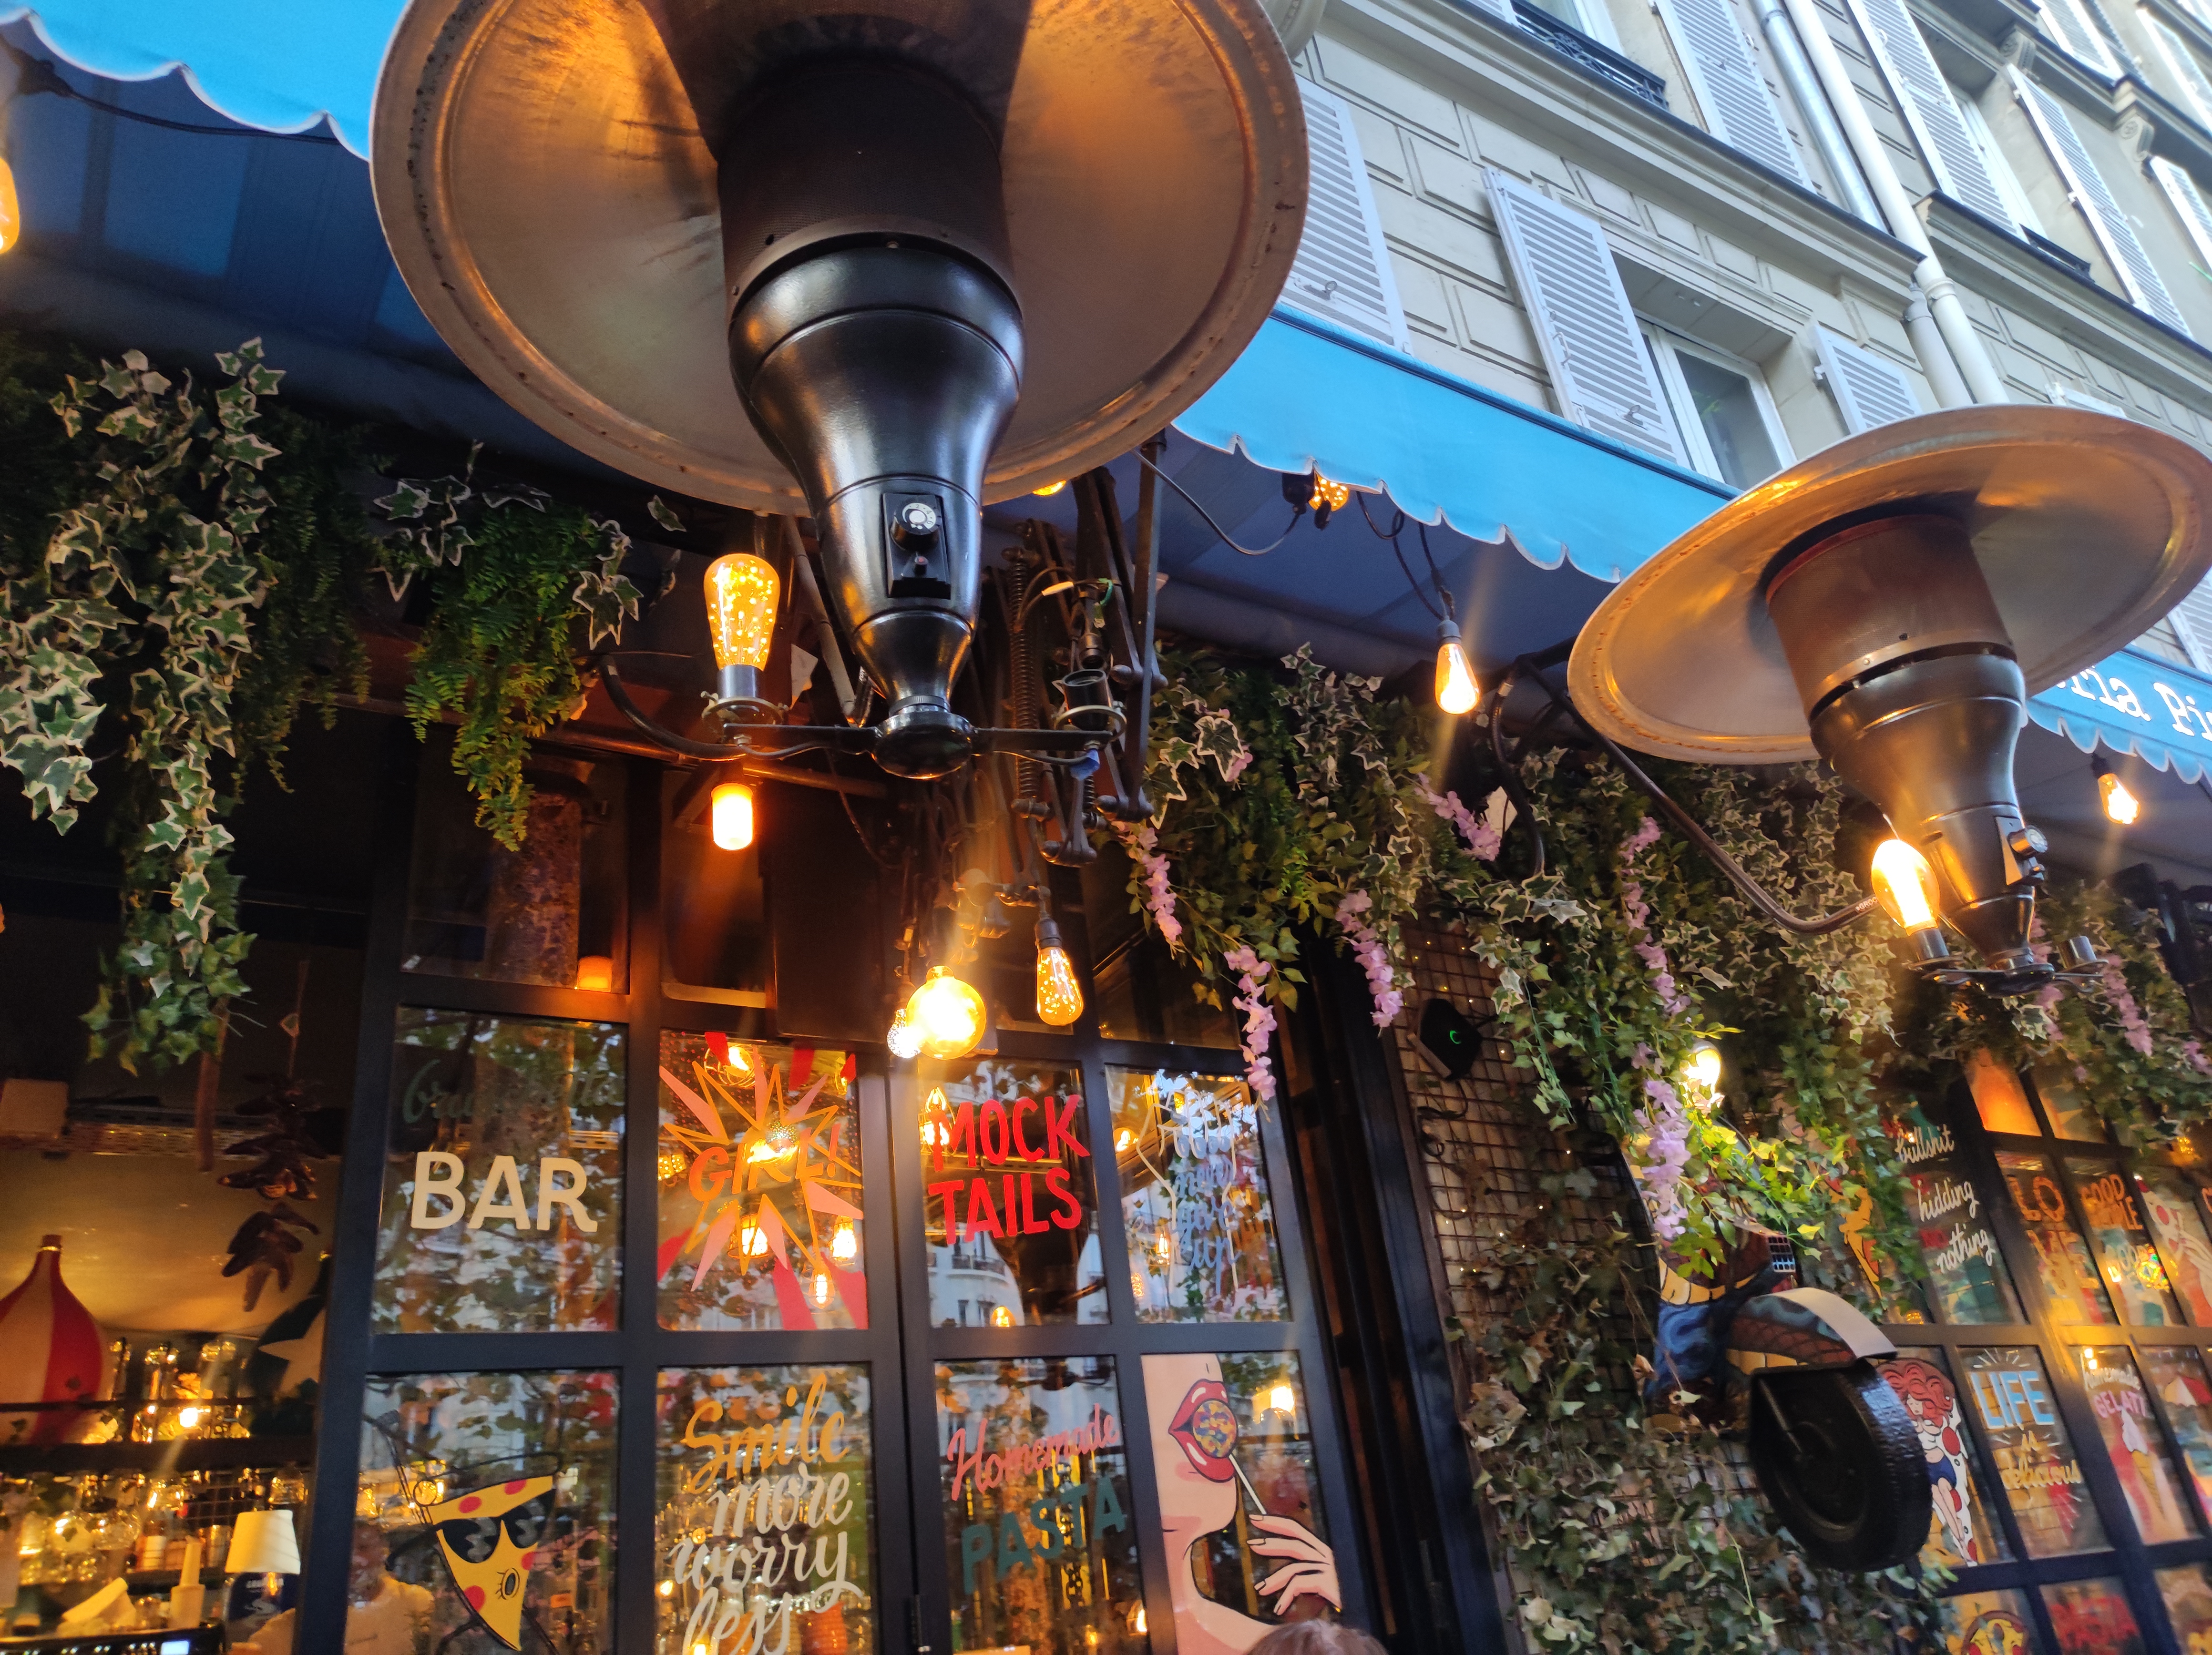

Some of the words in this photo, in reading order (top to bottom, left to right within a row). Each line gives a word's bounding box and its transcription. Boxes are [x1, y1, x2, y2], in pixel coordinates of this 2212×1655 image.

[2152, 681, 2212, 742] Pi
[931, 1094, 1090, 1171] MOCK
[1895, 1124, 1955, 1164] bullshit
[410, 1151, 598, 1233] BAR
[928, 1167, 1083, 1245] TAILS
[1188, 1235, 1243, 1295] up
[1936, 1222, 1996, 1274] nothing
[680, 1372, 850, 1494] Smile
[1970, 1370, 2055, 1430] LIFE
[947, 1402, 1120, 1501] Homemade
[706, 1462, 853, 1538] more
[961, 1475, 1126, 1596] PASTA
[668, 1531, 863, 1614] worry
